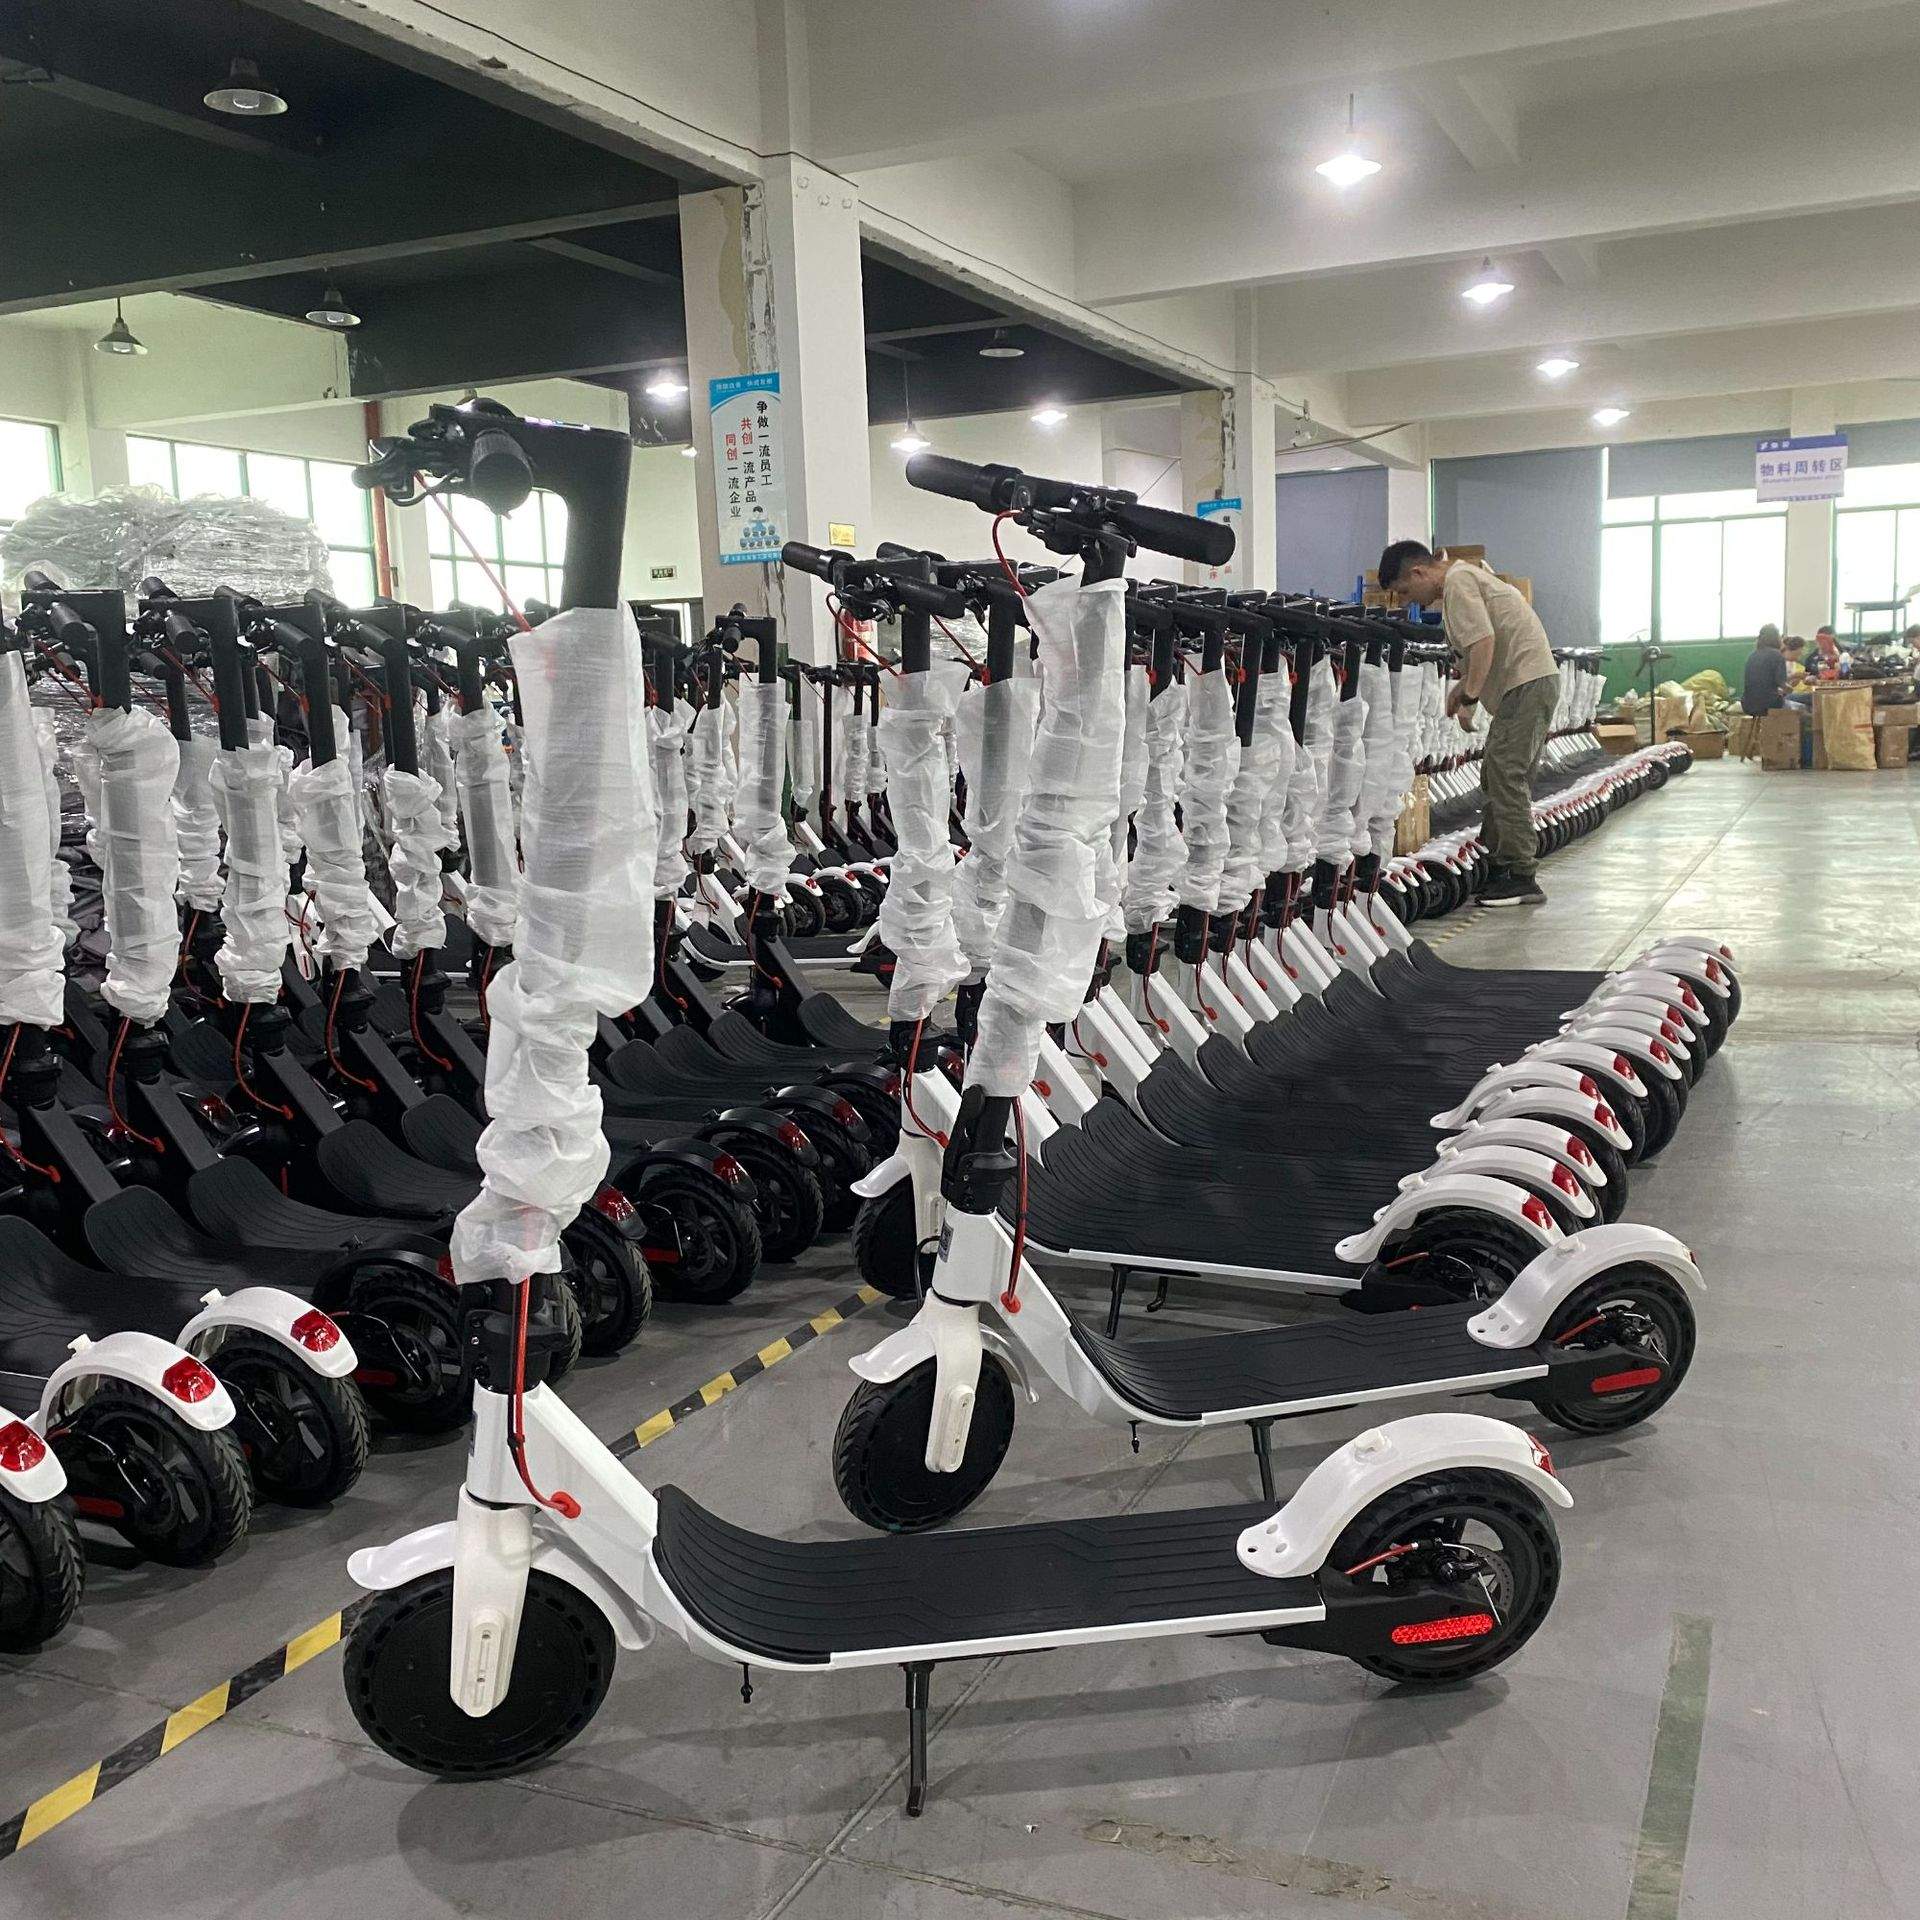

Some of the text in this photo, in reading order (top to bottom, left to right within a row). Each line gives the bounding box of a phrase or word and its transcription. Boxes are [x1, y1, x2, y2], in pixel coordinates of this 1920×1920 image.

[725, 433, 742, 518] 同创一流企业
[741, 417, 757, 503] 共创一流产品
[756, 400, 773, 486] 争做一流员工
[1760, 458, 1843, 476] 物料周转区
